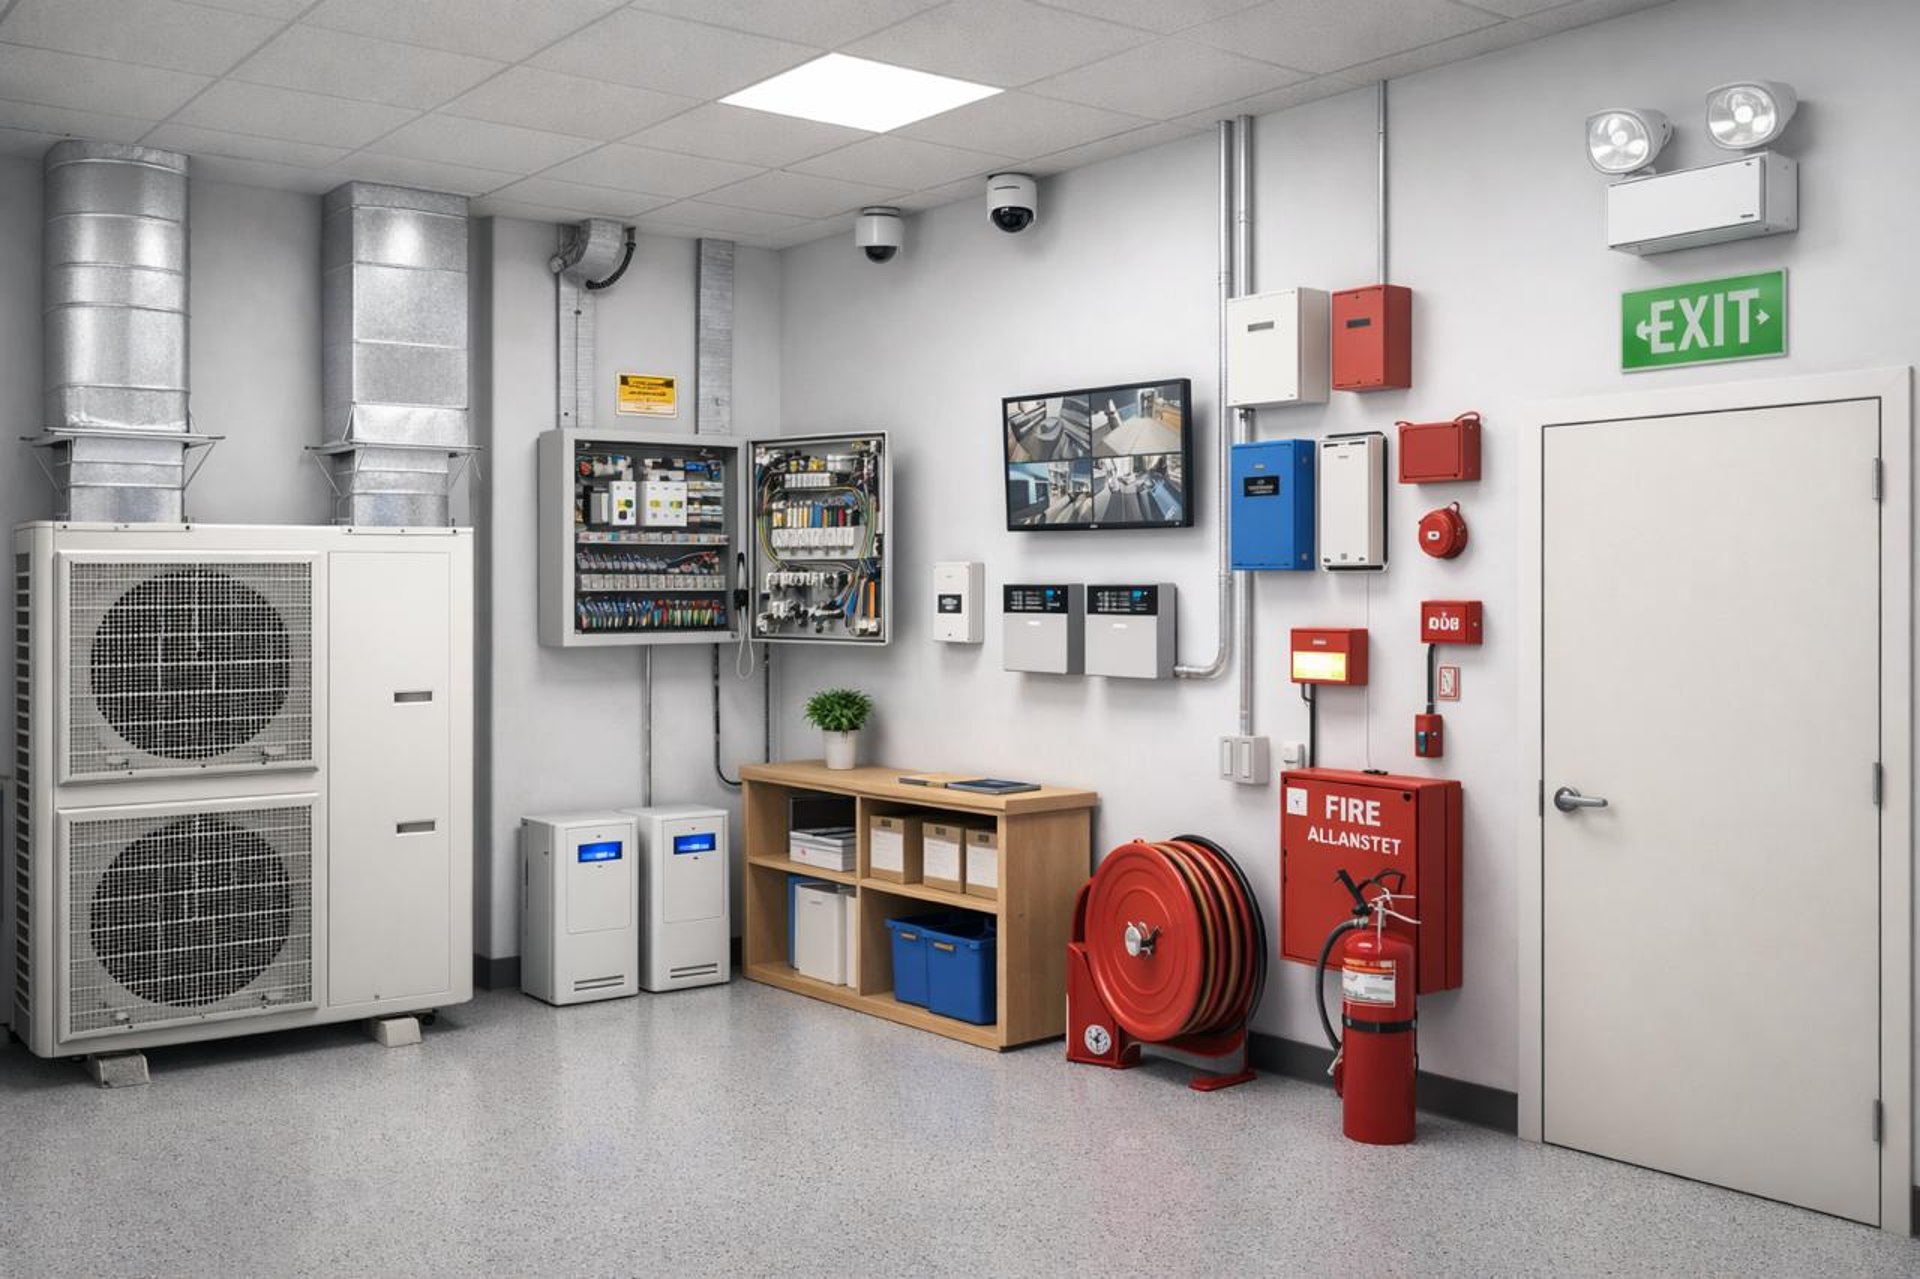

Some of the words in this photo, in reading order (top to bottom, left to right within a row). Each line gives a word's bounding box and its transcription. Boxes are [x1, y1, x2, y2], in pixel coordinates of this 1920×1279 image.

[1651, 288, 1759, 354] EXIT
[1325, 794, 1381, 827] FIRE
[1307, 825, 1402, 856] ALLANSTET
